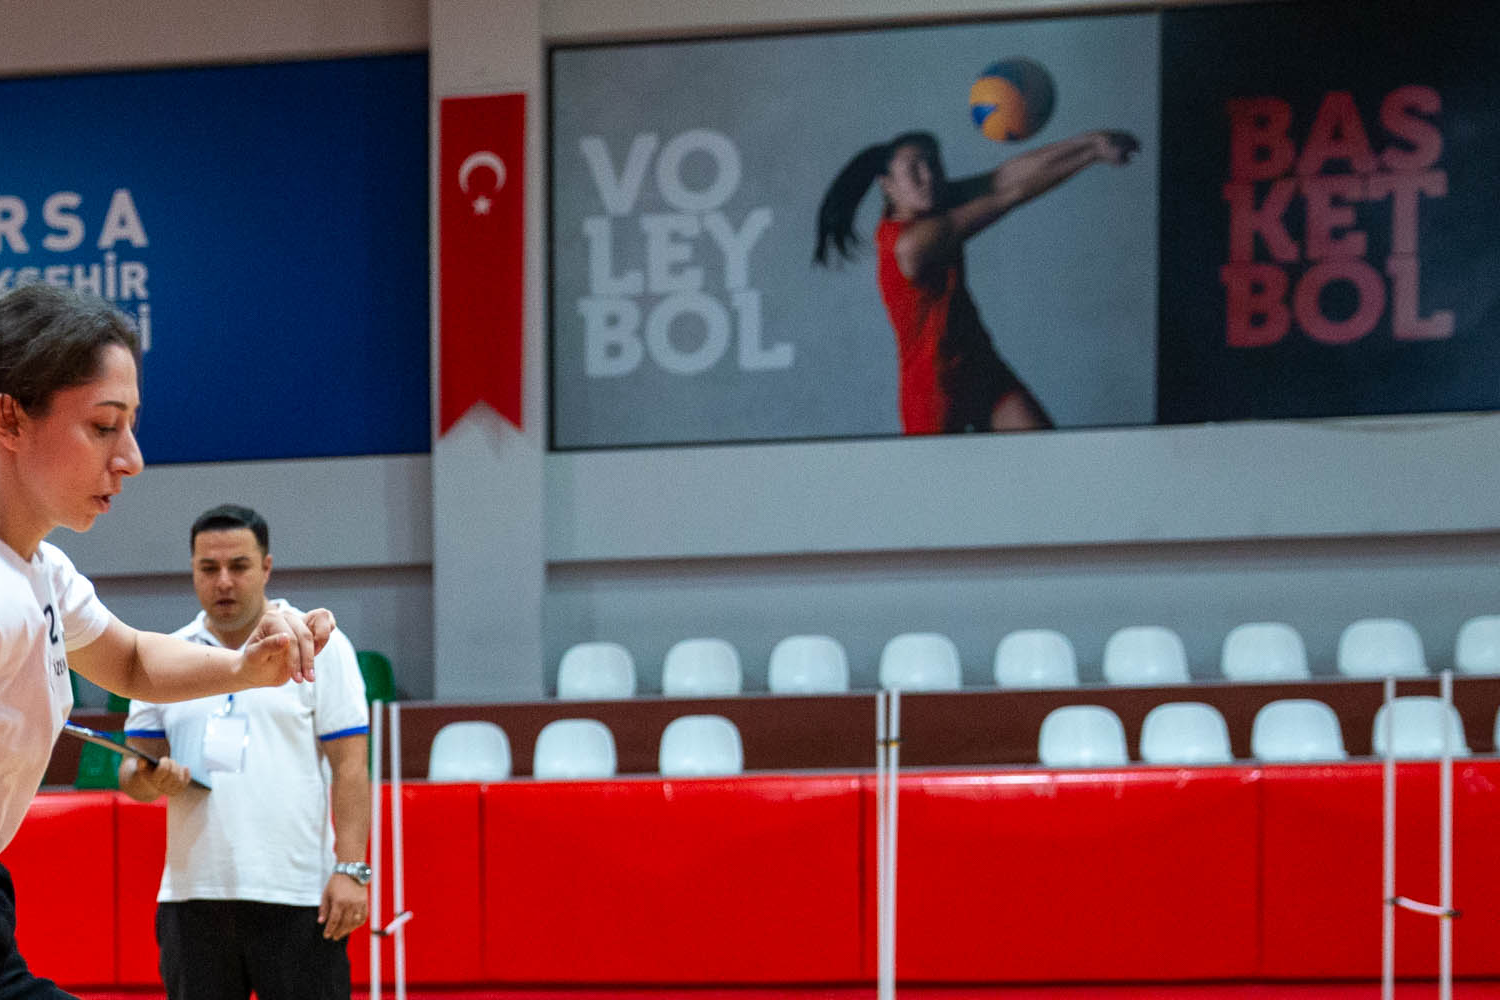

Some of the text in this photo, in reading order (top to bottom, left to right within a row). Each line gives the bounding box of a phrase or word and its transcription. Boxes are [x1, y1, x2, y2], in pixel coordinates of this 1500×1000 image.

[579, 127, 743, 217] VO
[1224, 84, 1443, 180] BAS
[582, 205, 773, 296] LEY
[1222, 171, 1449, 264] KET
[577, 288, 796, 379] BOL
[1219, 254, 1456, 348] BOL
[43, 603, 65, 645] 2
